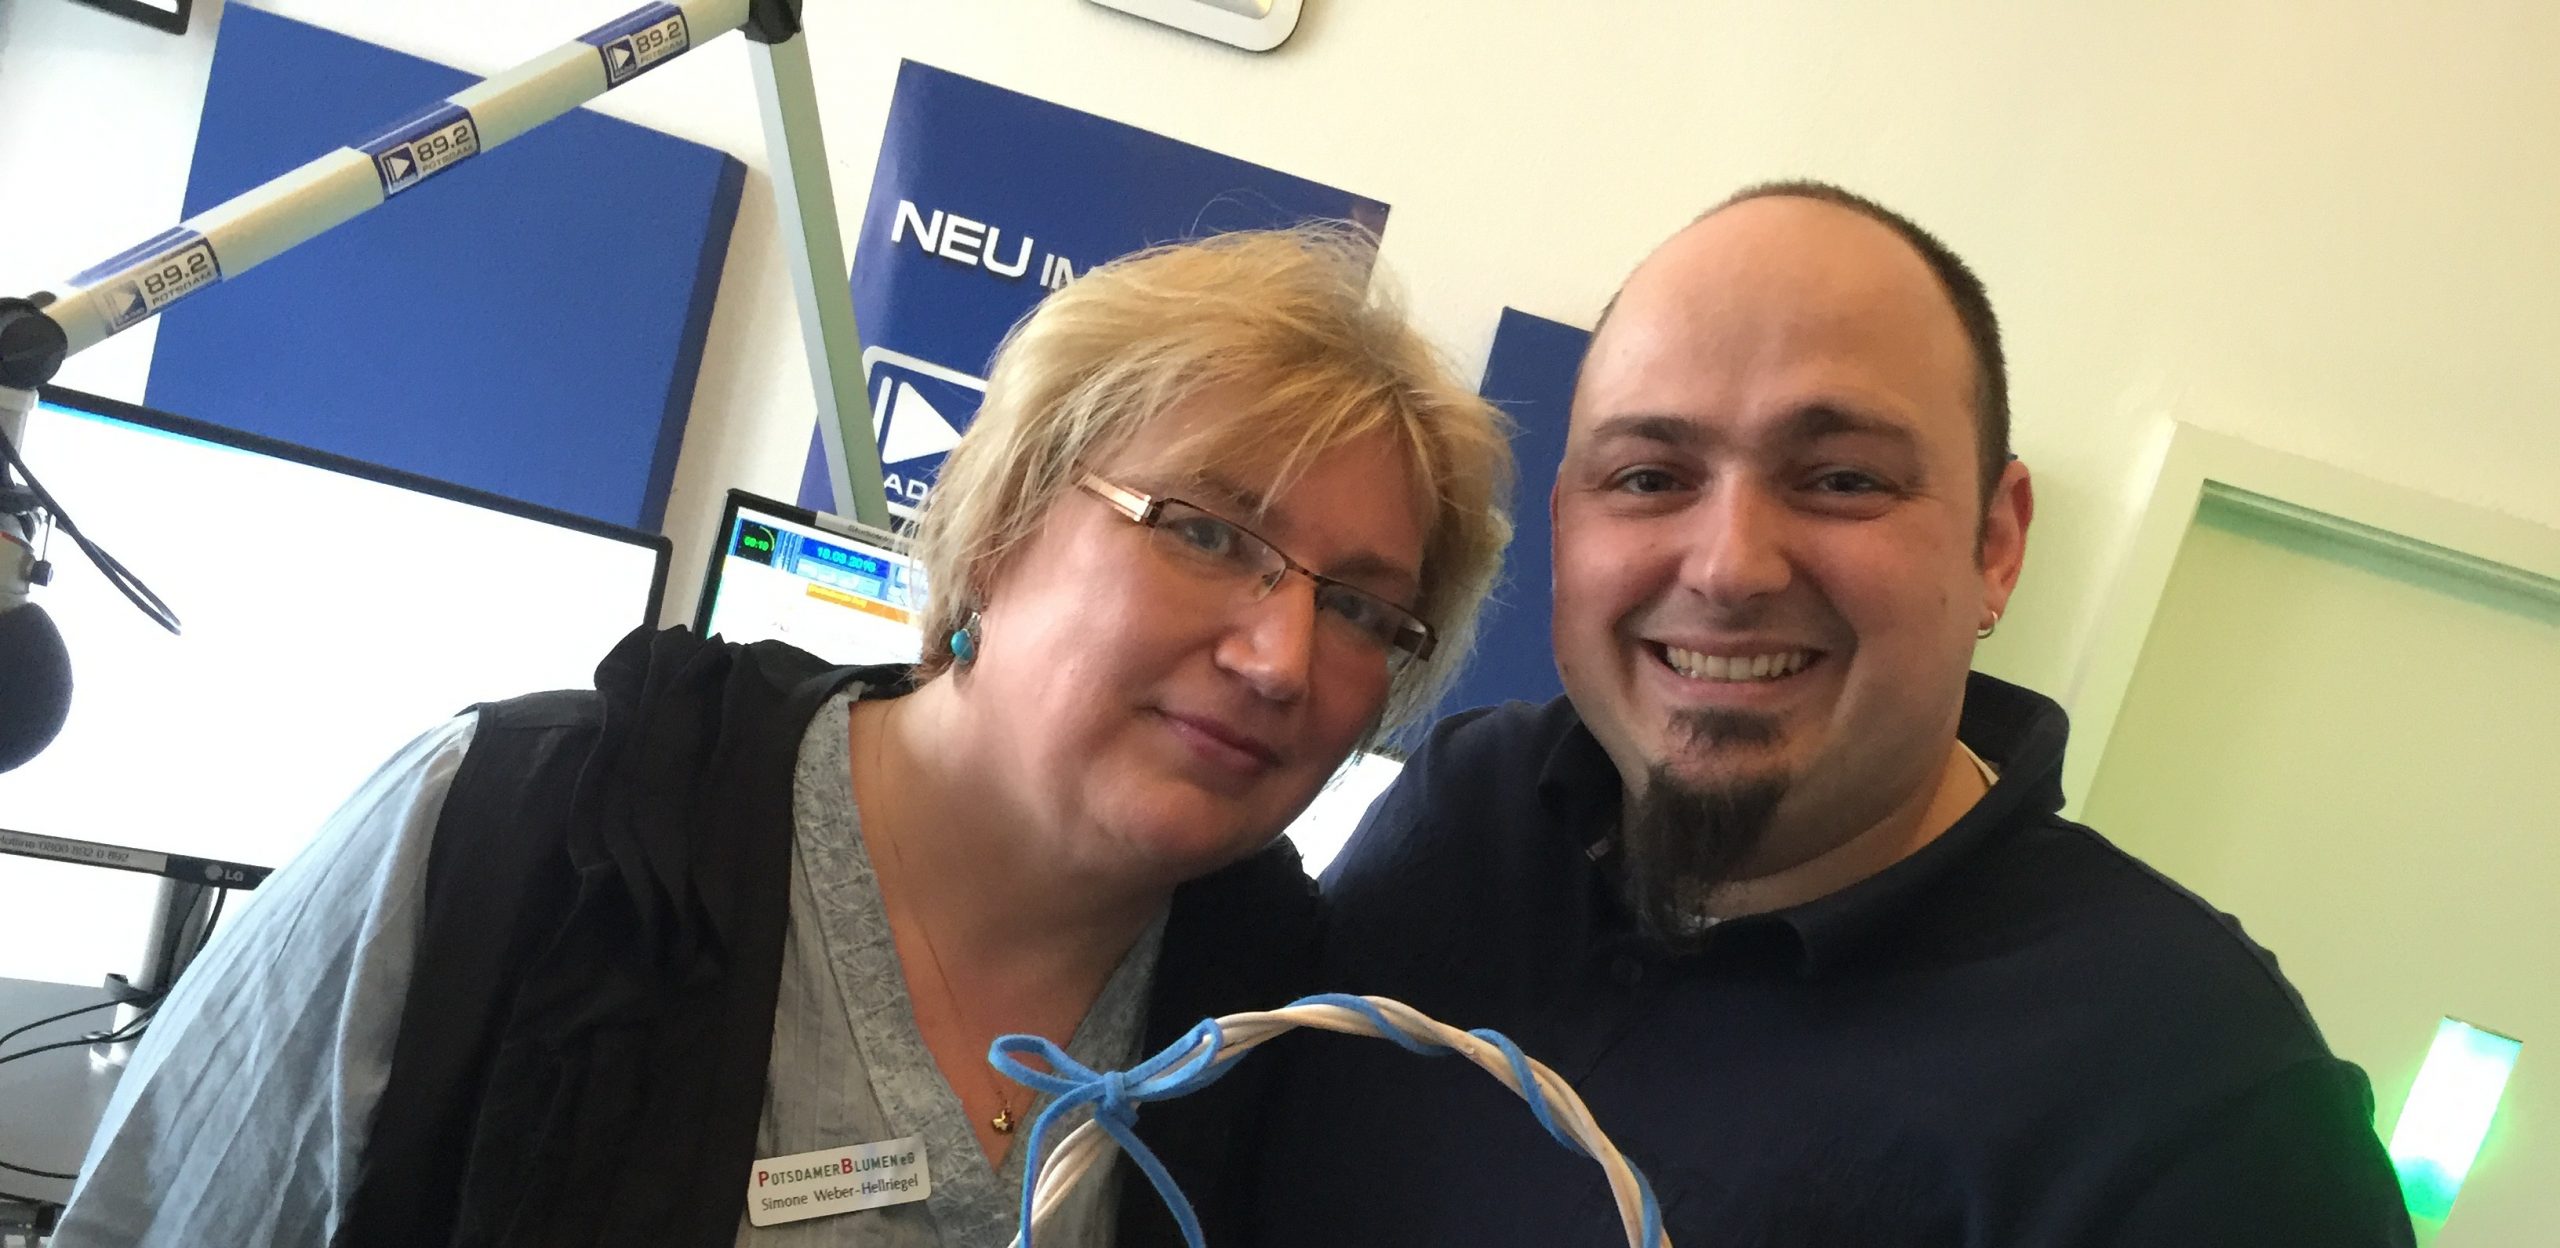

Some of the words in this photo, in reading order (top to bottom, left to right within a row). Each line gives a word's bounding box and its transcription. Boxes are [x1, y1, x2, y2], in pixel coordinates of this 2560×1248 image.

[636, 21, 682, 54] 89.2
[416, 124, 471, 162] 89.2
[891, 199, 1034, 278] NEU
[144, 252, 208, 296] 89.2
[152, 270, 213, 306] POTSDAM
[761, 1193, 809, 1212] Simone
[813, 1172, 919, 1203] Weber-Hellriegel
